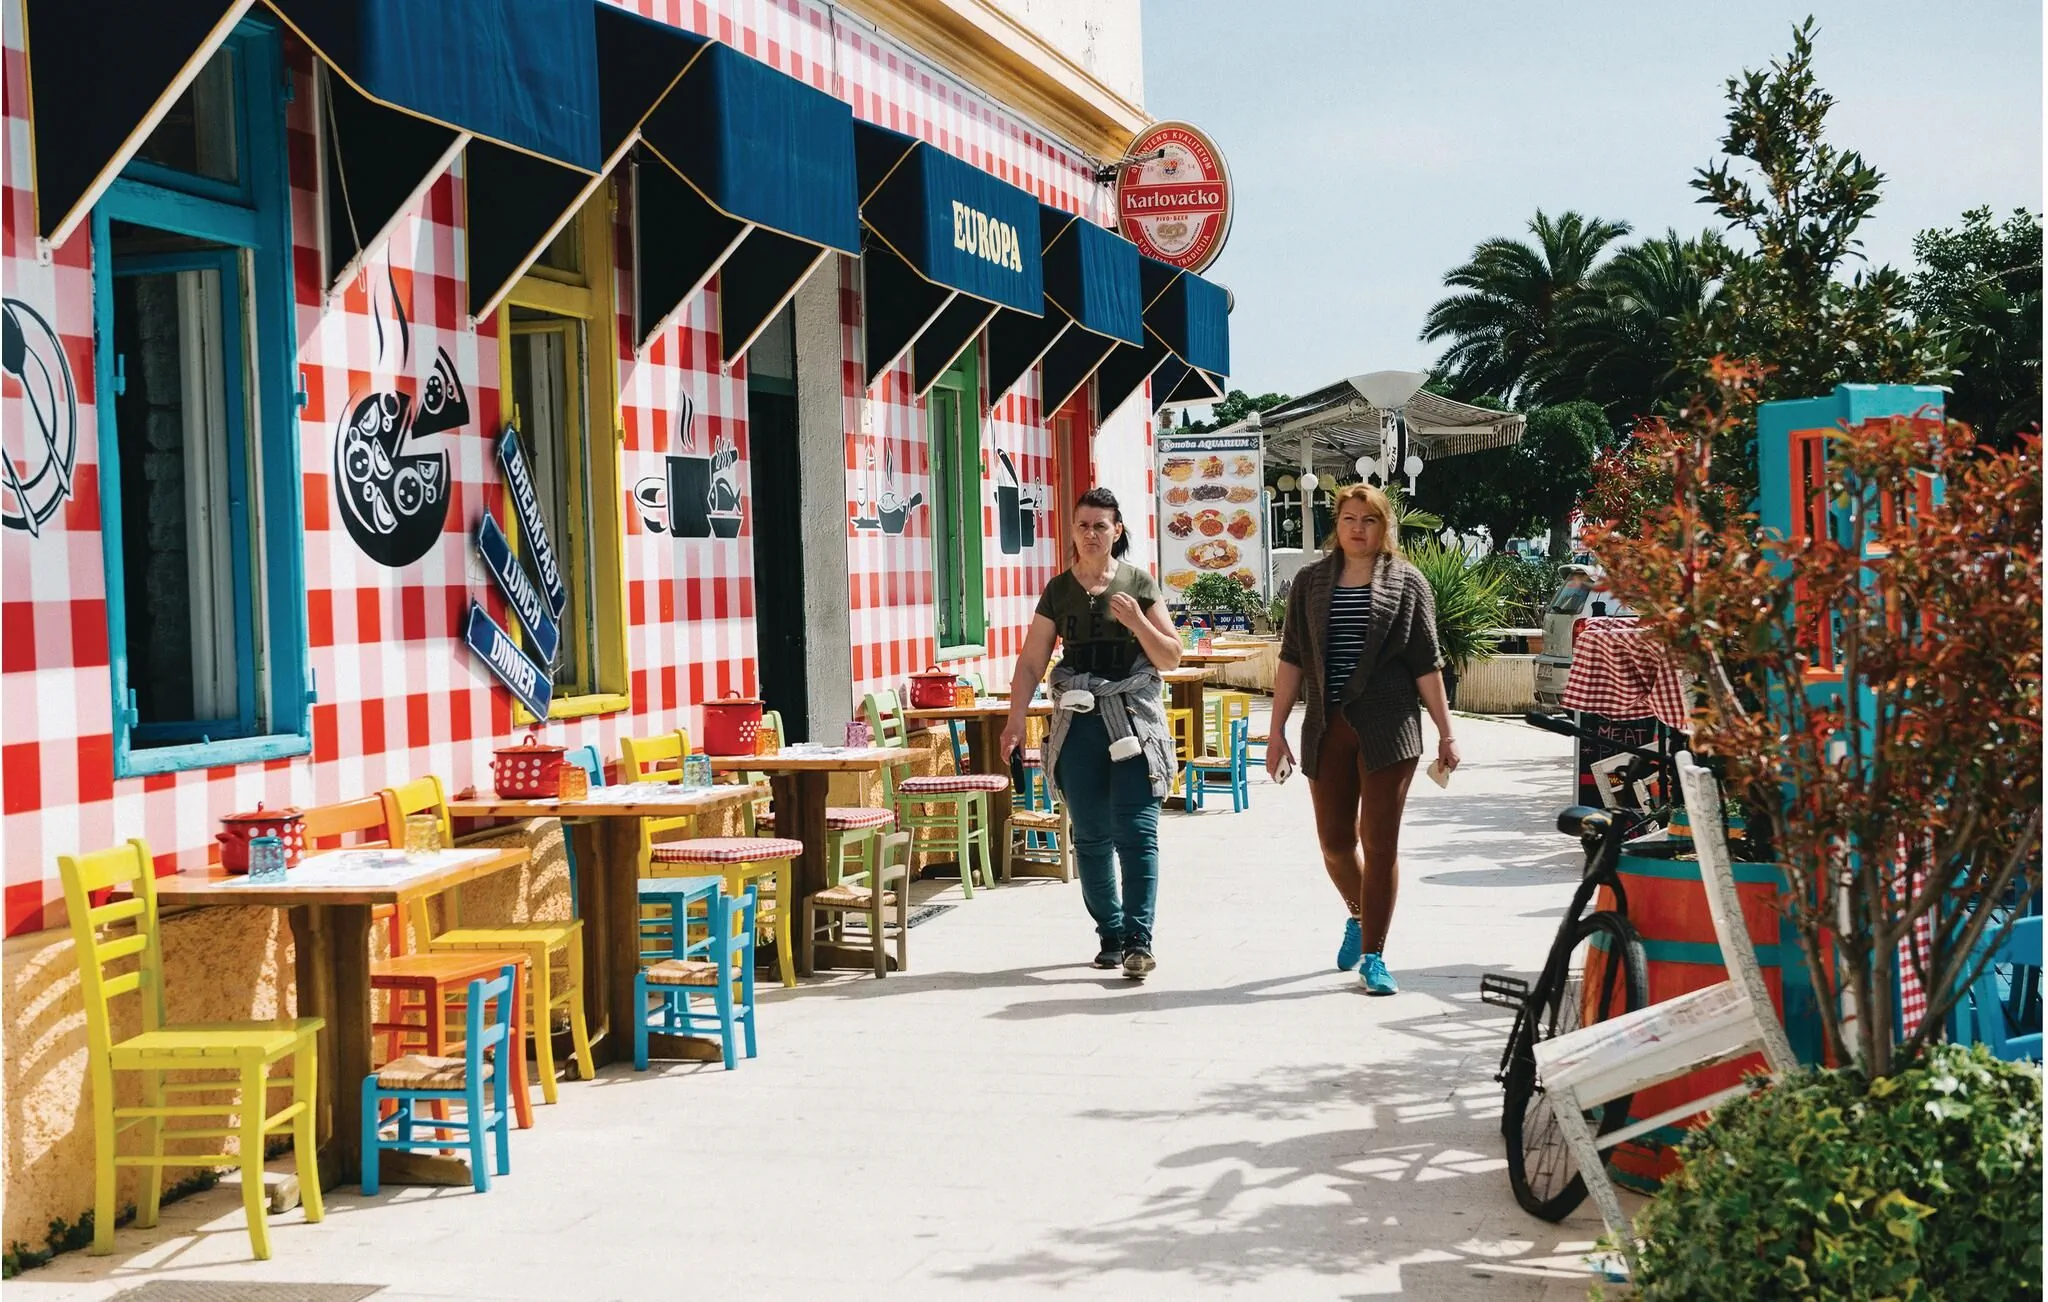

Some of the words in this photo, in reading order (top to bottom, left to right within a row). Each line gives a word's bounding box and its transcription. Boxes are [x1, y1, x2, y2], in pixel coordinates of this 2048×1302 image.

[1172, 131, 1213, 171] KVALITETOM
[1126, 189, 1220, 210] Karlovačko
[952, 199, 1023, 273] EUROPA
[1177, 235, 1211, 267] TRADICIJA
[1162, 441, 1197, 450] Konoba
[1197, 438, 1250, 450] AQUARIUM
[509, 451, 564, 599] BREAKFAST
[502, 551, 543, 632] LUNCH
[489, 629, 538, 700] DINNER
[1597, 725, 1648, 745] MEAT
